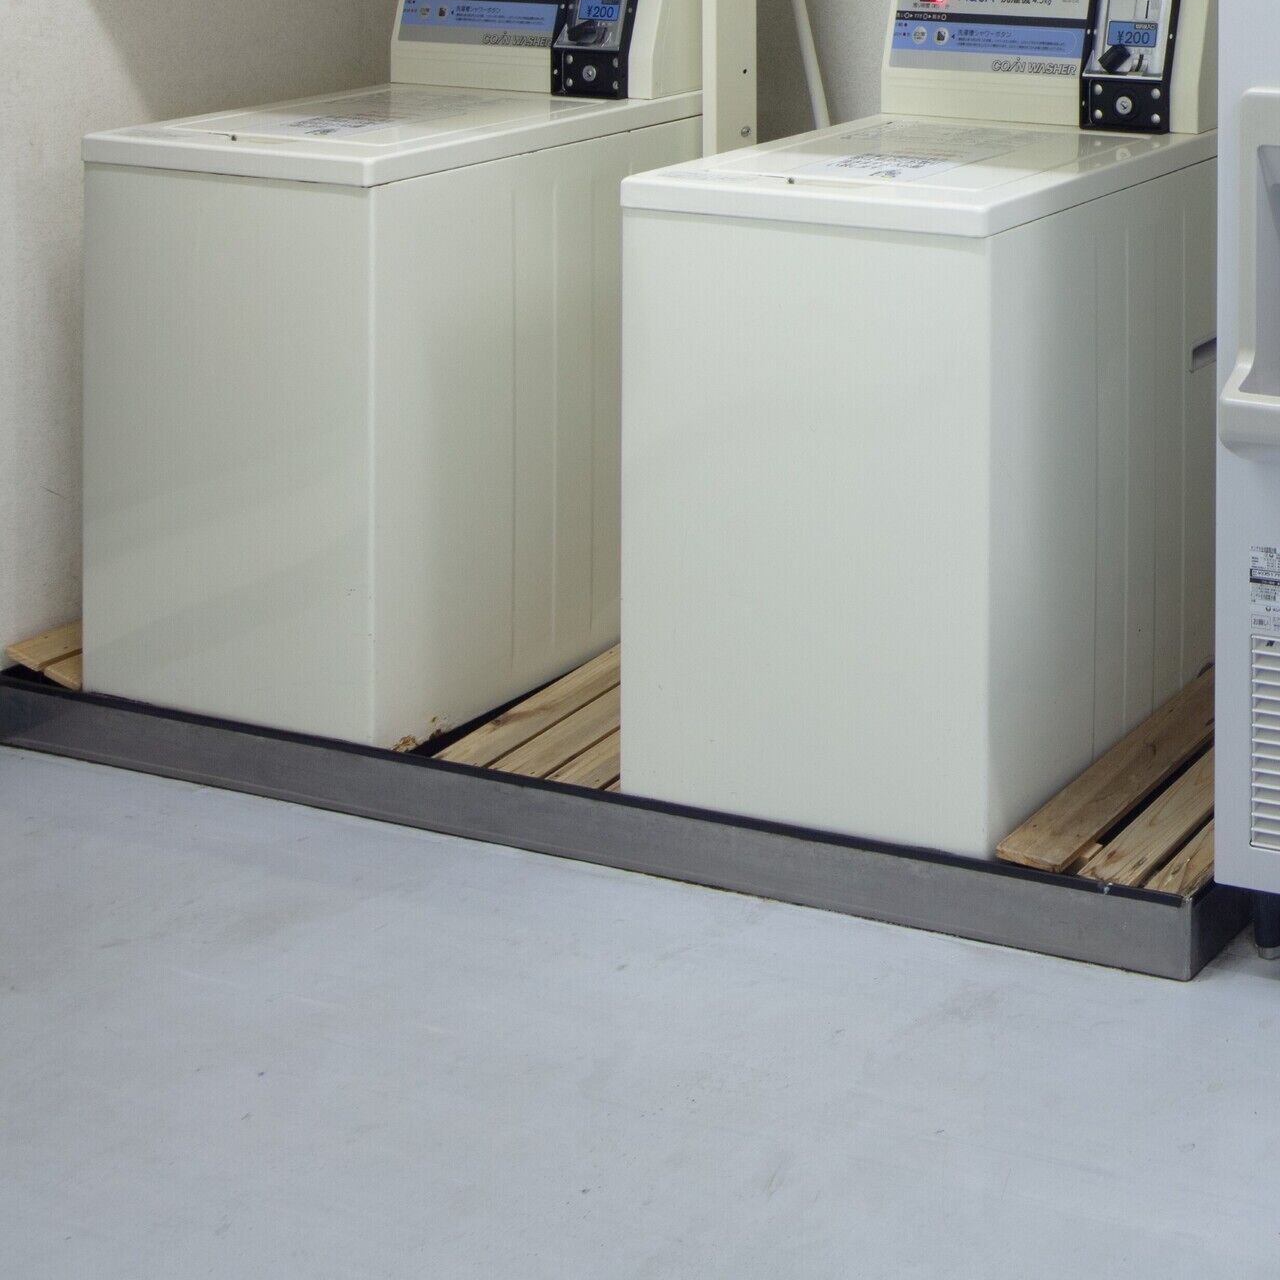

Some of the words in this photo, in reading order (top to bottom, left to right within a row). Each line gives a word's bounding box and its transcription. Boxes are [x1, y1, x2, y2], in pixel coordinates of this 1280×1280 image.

[586, 5, 615, 19] ¥200
[1116, 30, 1150, 46] ¥200
[991, 55, 1026, 73] COIN
[1027, 60, 1077, 76] WASHER
